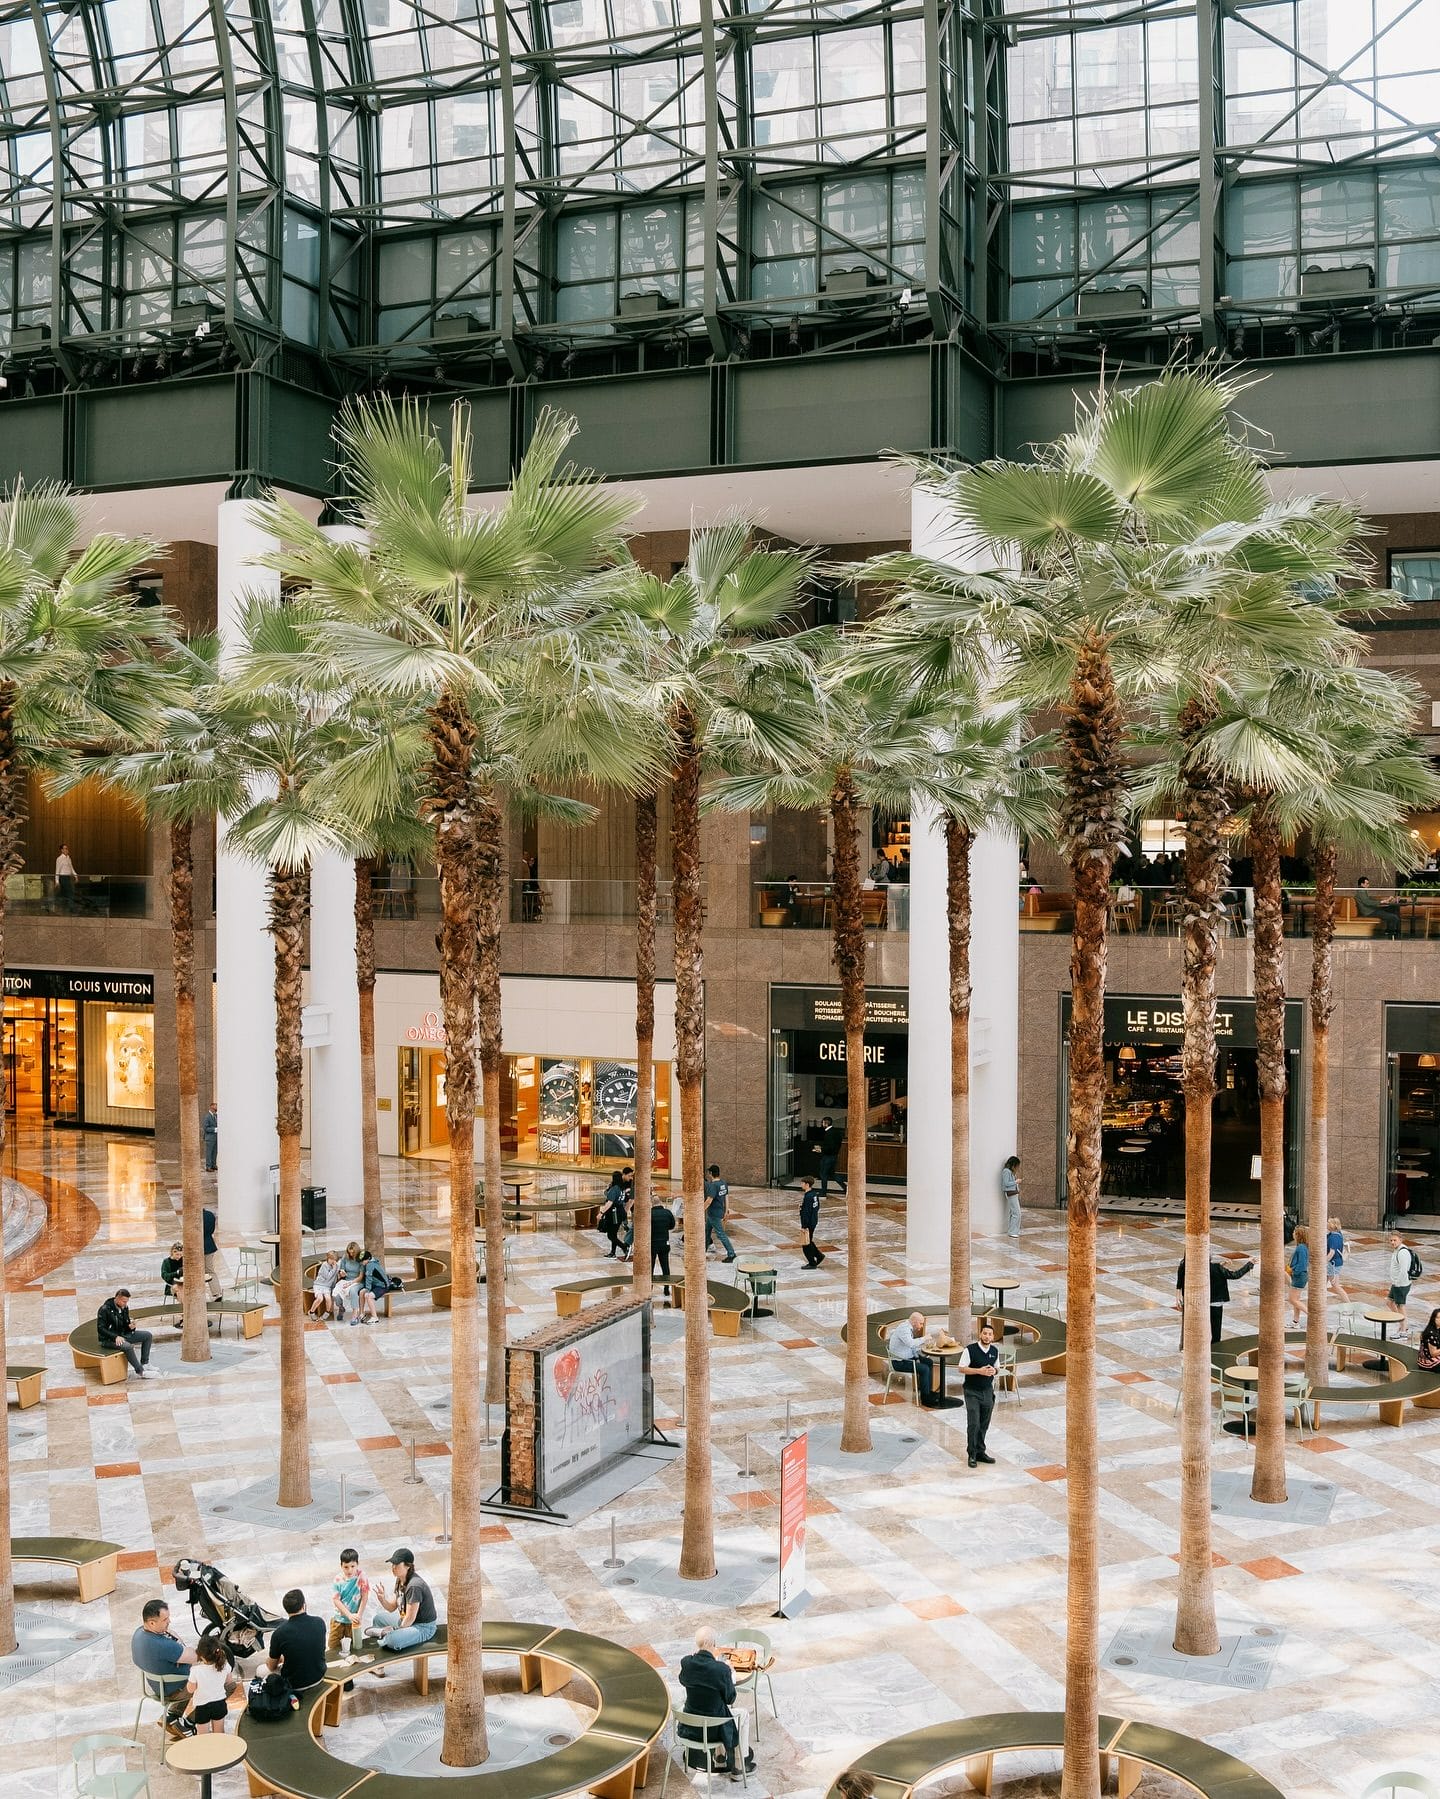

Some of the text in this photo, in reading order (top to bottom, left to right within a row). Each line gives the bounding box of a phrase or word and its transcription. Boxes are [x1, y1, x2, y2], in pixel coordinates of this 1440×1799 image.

[69, 980, 151, 995] LOUIS VUITTON
[873, 1009, 907, 1017] BOUCHERIE
[1127, 1010, 1233, 1028] LE DISCT
[406, 1027, 446, 1041] OMEG
[1156, 1026, 1185, 1034] RESTAUR
[819, 1040, 885, 1064] CRÊRIE
